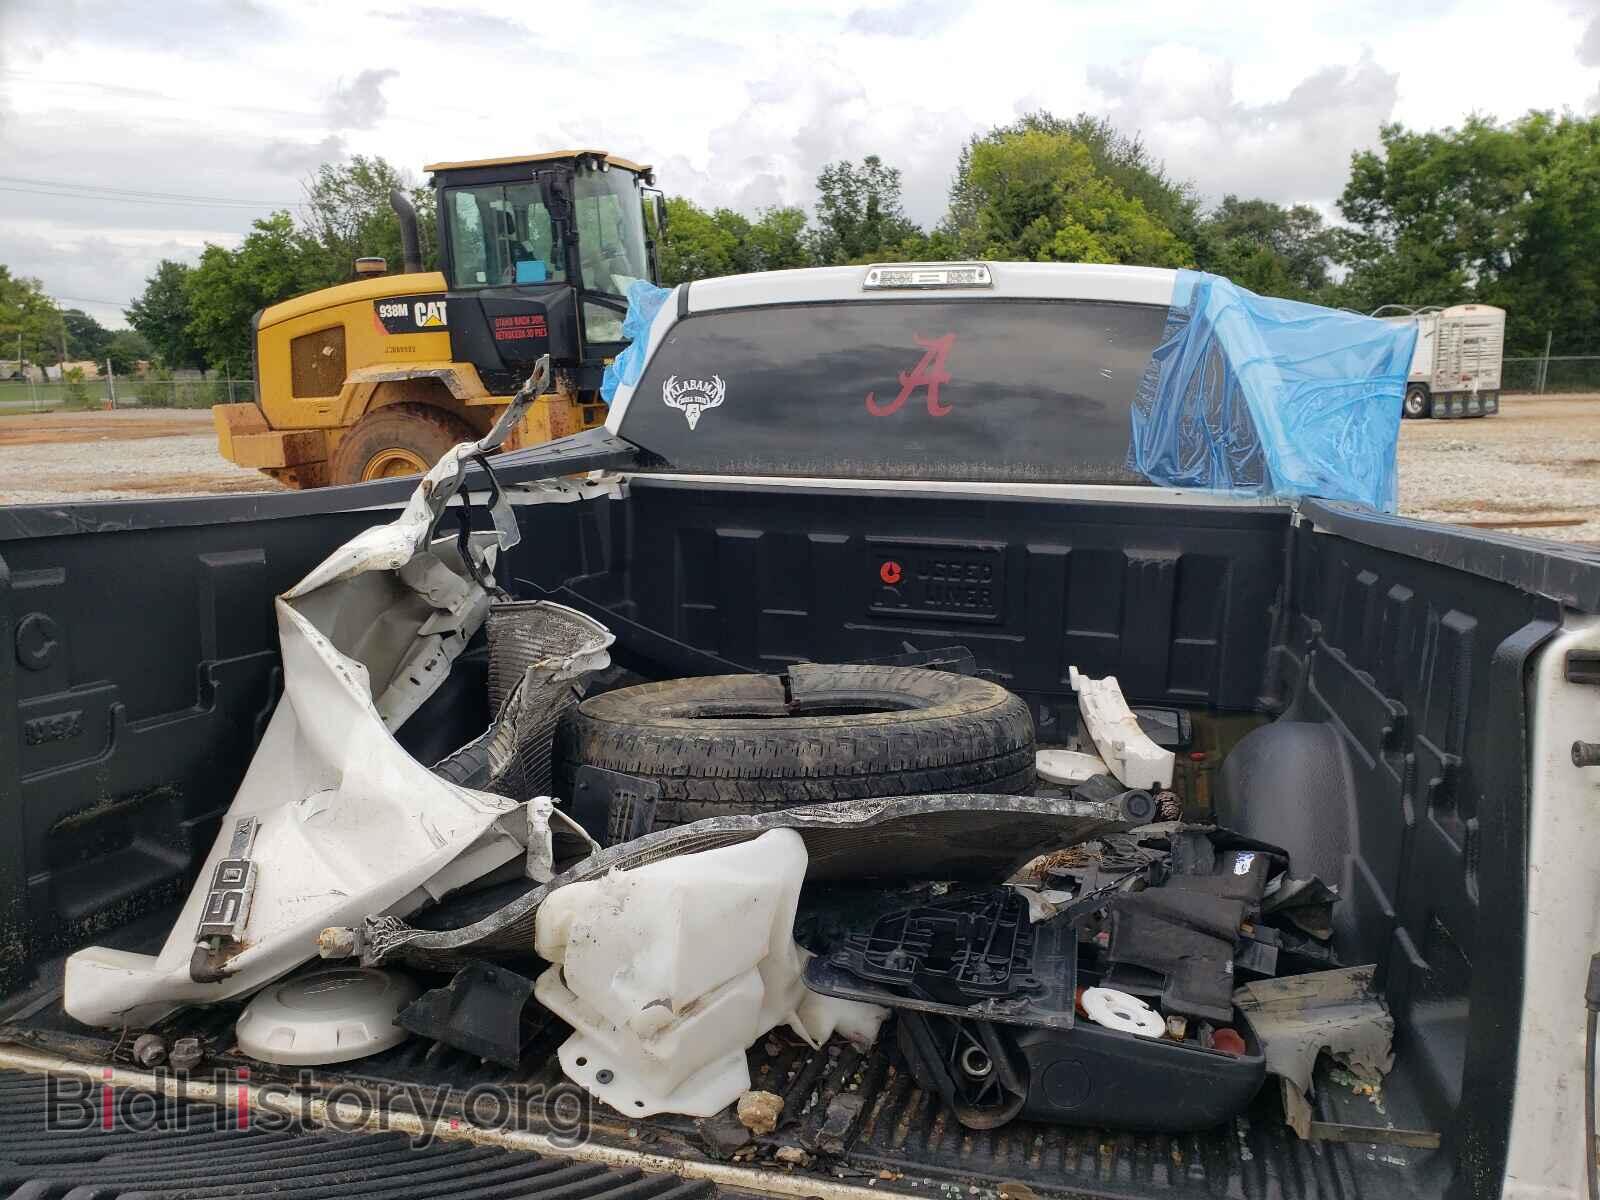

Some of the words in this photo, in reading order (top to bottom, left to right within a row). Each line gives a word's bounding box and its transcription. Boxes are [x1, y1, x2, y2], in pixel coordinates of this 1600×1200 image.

[379, 303, 409, 318] 938M
[414, 301, 448, 327] CAT
[865, 331, 956, 417] A
[671, 379, 719, 399] ALABAMA
